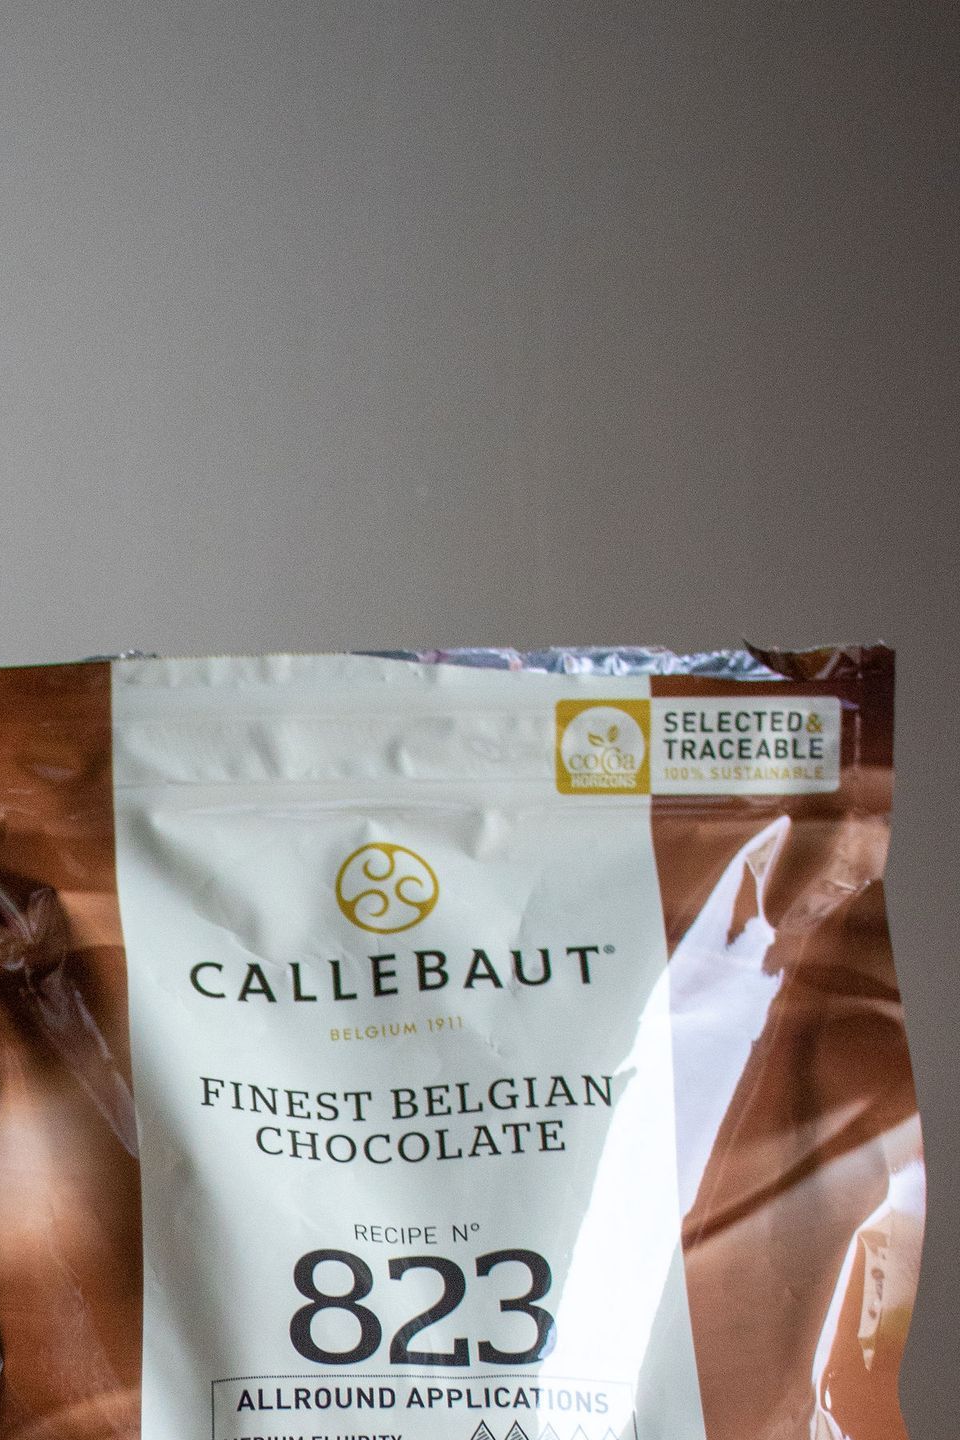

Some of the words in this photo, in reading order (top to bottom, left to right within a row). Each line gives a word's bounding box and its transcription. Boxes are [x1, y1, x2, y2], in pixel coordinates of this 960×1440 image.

[664, 738, 824, 761] TRACEABLE
[664, 766, 704, 780] 100%
[710, 766, 825, 780] SUSTAINABLE
[330, 1022, 418, 1042] BELGIUM
[427, 1016, 464, 1032] 1911
[200, 1076, 372, 1122] FINEST
[390, 1075, 614, 1121] BELGIAN
[255, 1119, 566, 1165] CHOCOLATE
[353, 1223, 438, 1244] RECIPE
[289, 1248, 557, 1367] 823
[237, 1387, 395, 1413] ALLROUND
[406, 1386, 610, 1414] APPLICATIONS
